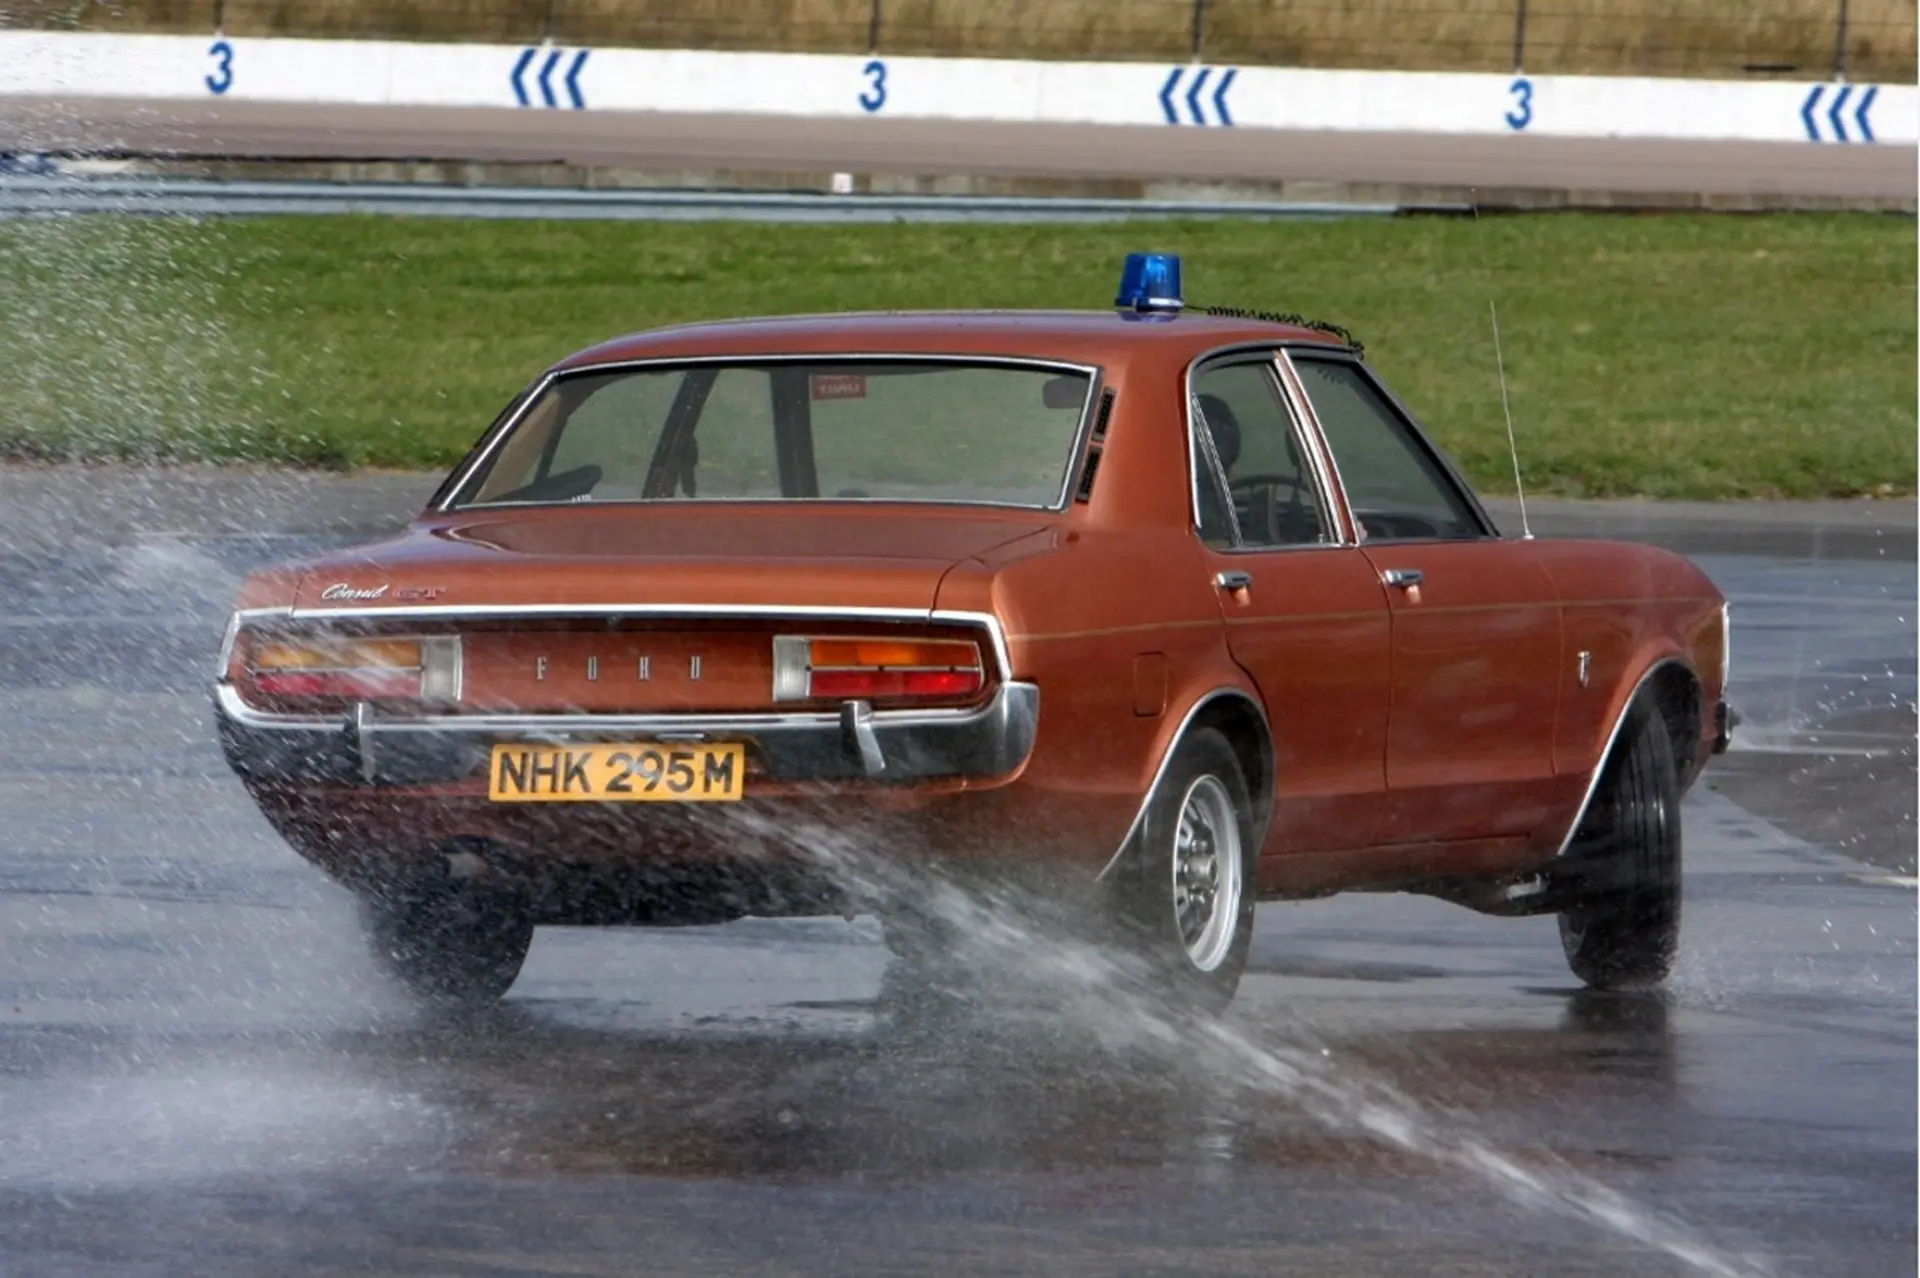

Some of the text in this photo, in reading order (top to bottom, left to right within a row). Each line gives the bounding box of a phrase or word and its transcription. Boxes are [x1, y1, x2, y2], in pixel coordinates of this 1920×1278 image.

[205, 41, 232, 95] 3
[859, 60, 887, 112] 3
[1505, 79, 1532, 131] 3
[536, 656, 701, 681] FORD
[498, 750, 735, 794] NHK 295M
